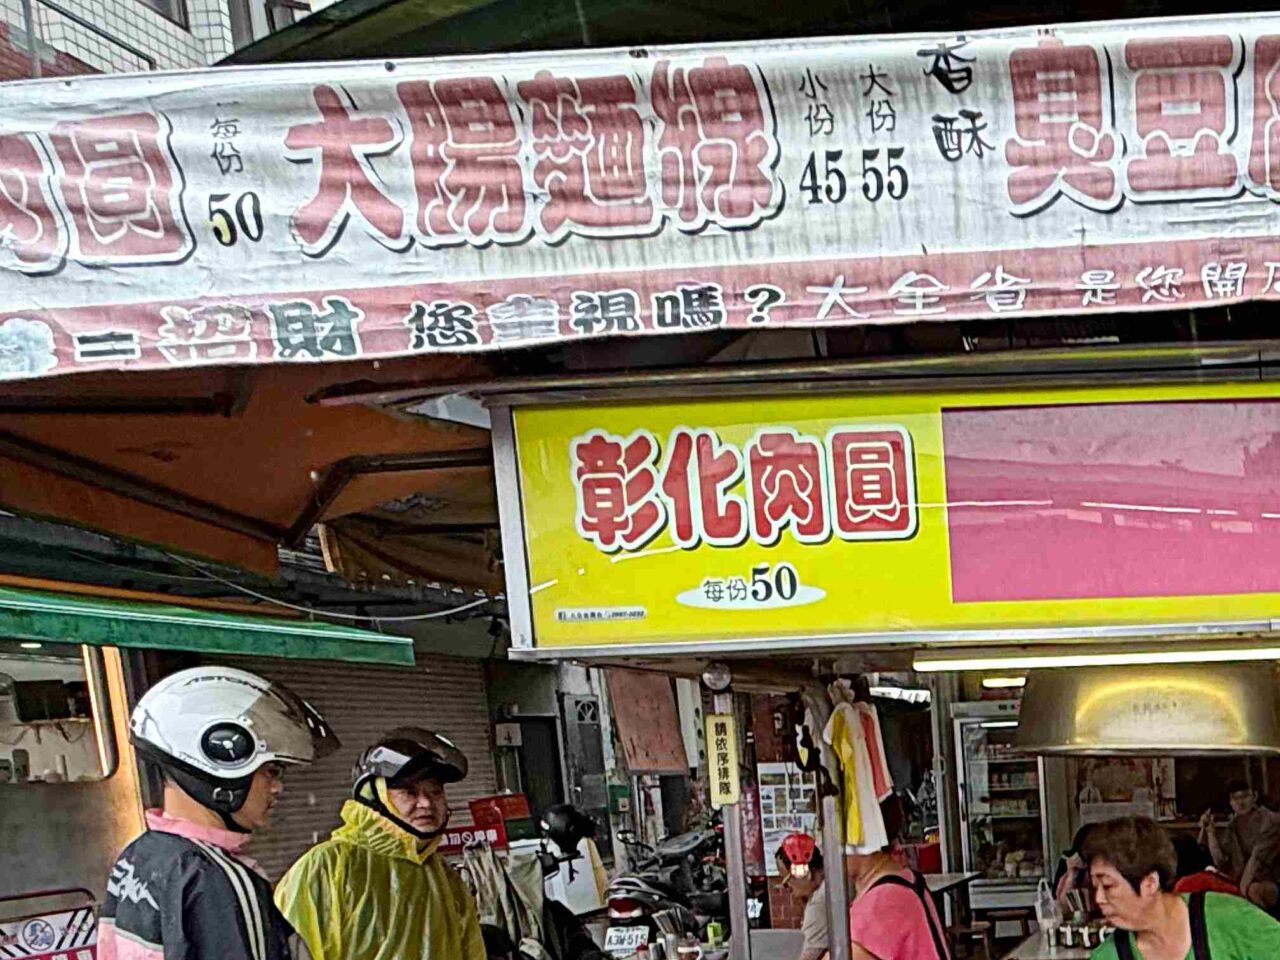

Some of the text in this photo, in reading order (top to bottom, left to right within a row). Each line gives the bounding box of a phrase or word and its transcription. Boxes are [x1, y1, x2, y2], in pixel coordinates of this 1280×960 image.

[798, 66, 834, 136] 小份
[859, 63, 895, 134] 大份
[916, 42, 996, 162] 香酥
[210, 117, 244, 176] 每份
[284, 57, 772, 248] 大腸麵線
[799, 149, 847, 204] 45
[861, 146, 909, 203] 55
[207, 191, 265, 247] 50
[806, 264, 1029, 319] 大全省
[572, 424, 914, 548] 彰化肉圓
